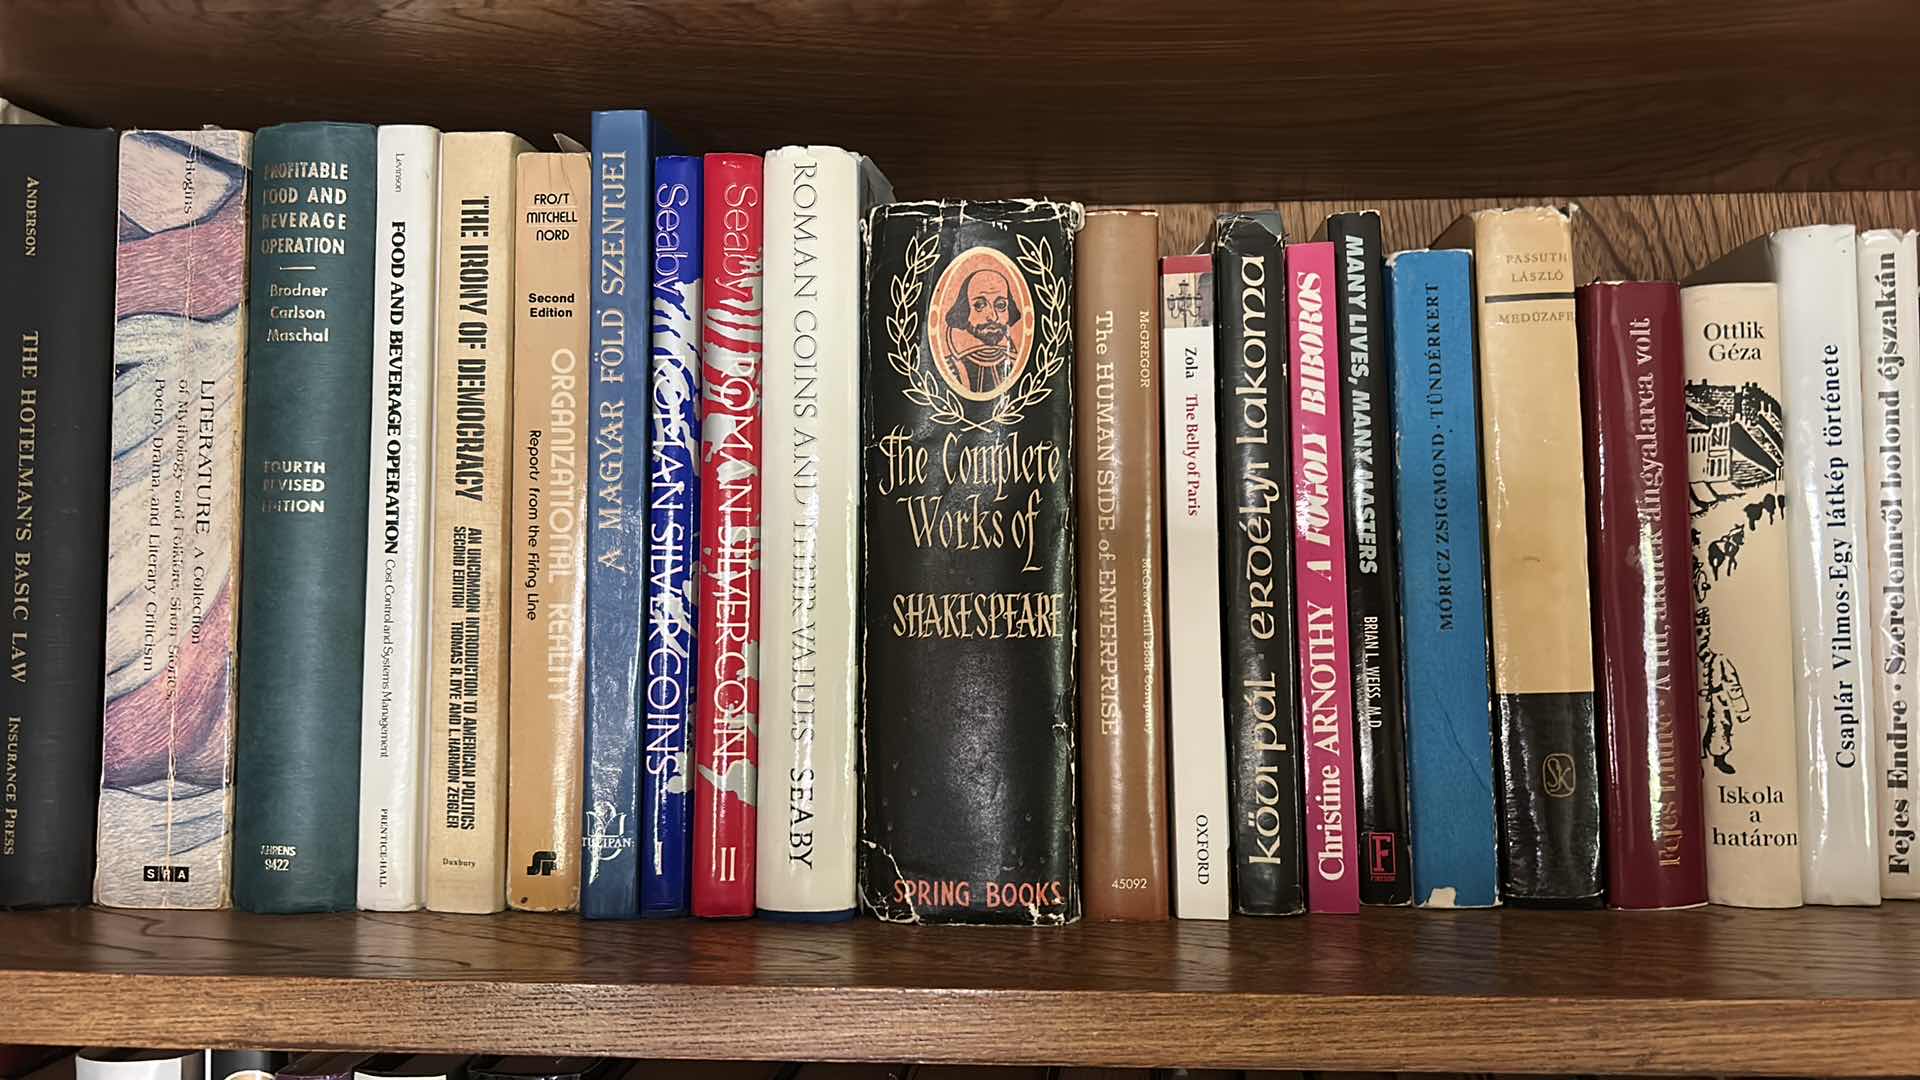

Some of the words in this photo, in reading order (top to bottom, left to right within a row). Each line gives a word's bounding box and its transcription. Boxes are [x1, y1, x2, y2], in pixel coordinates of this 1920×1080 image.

[183, 160, 196, 214] Hogins
[264, 162, 349, 180] PROFITABLE
[307, 187, 347, 205] AND
[24, 176, 40, 257] ANDERSON
[262, 212, 347, 230] BEVERAGE
[460, 196, 489, 237] THE
[527, 211, 577, 223] MITCHELL
[536, 229, 569, 241] NORD
[601, 151, 626, 296] SZENTJEI
[655, 183, 688, 296] Seaby
[715, 183, 758, 297] Seaby
[793, 162, 818, 298] ROMAN
[262, 237, 345, 255] OPERATION
[391, 221, 405, 278] FOOD
[1346, 235, 1368, 309] MANY
[1506, 252, 1568, 264] PASSUTH
[271, 283, 329, 297] Brodner
[459, 245, 489, 315] IRONY
[528, 293, 575, 303] Second
[1511, 269, 1564, 282] LÁSZLÓ
[271, 305, 326, 319] Carlson
[390, 282, 405, 325] AND
[529, 307, 573, 318] Edition
[1875, 252, 1905, 381] éjszakán
[21, 331, 39, 378] THE
[267, 327, 329, 342] Maschal
[458, 322, 488, 350] OF
[593, 308, 624, 383] FÖLD
[1096, 311, 1113, 354] The
[1139, 311, 1151, 388] McGREGOR
[1296, 271, 1327, 416] BIBOROS
[1348, 311, 1370, 385] LIVES,
[1424, 282, 1444, 419] TÜNDÉRKERT
[1630, 317, 1654, 366] volt
[1704, 321, 1765, 340] Ottlik
[1709, 344, 1762, 361] Géza
[178, 379, 189, 395] of
[387, 331, 404, 438] BEVERAGE
[793, 310, 818, 418] COINS
[1184, 347, 1197, 378] Zola
[1096, 362, 1115, 461] HUMAN
[1185, 394, 1198, 420] The
[1821, 344, 1842, 447] története
[454, 359, 487, 502] DEMOCRACY
[651, 354, 686, 510] ROMAN
[717, 357, 754, 512] ROMAN
[1183, 423, 1200, 458] Belly
[1351, 390, 1373, 464] MANY
[1878, 390, 1901, 489] bolond
[15, 389, 37, 542] HOTELMAN'S
[150, 437, 164, 492] Drama,
[193, 380, 215, 534] LITERATURE
[264, 460, 326, 474] FOURTH
[527, 430, 541, 481] Reports
[548, 349, 576, 584] ORGANIZATIONAL
[596, 400, 625, 530] MAGYAR
[793, 427, 817, 505] AND
[878, 425, 928, 496] The
[943, 431, 1060, 502] Complete
[1186, 460, 1200, 477] of
[149, 498, 161, 526] and
[384, 441, 401, 554] OPERATION
[527, 487, 540, 525] from
[1097, 470, 1116, 530] SIDE
[1187, 480, 1201, 516] Paris
[1302, 428, 1331, 547] FOGOLY
[1431, 434, 1449, 546] ZSIGMOND
[1825, 456, 1849, 527] látkép
[453, 526, 466, 564] SECOND
[468, 527, 482, 544] AN
[527, 527, 539, 547] the
[896, 494, 1004, 550] Works
[1011, 488, 1043, 573] of
[1354, 465, 1378, 574] MASTERS
[145, 535, 160, 595] Literary
[194, 547, 204, 559] A
[384, 559, 397, 584] Cost
[524, 552, 539, 589] Firing
[598, 547, 625, 573] A
[1098, 540, 1116, 560] of
[1307, 559, 1332, 582] A
[12, 551, 32, 620] BASIC
[191, 565, 204, 645] Collection
[382, 585, 396, 624] Control
[451, 566, 465, 609] EDITION
[466, 550, 482, 613] UNCOMMON
[527, 593, 539, 621] Line
[649, 522, 683, 640] SILVER
[714, 526, 752, 645] SILVER
[1436, 549, 1454, 632] MÓRICZ
[1881, 498, 1907, 674] Szerelemről
[143, 602, 157, 672] Criticism
[382, 625, 394, 645] and
[893, 592, 1064, 639] SHAKESPEARE
[1364, 616, 1378, 649] BRIAN
[10, 632, 27, 684] LAW
[380, 646, 394, 689] Systems
[450, 621, 463, 664] THOMAS
[464, 616, 481, 697] INTRODUCTION
[547, 603, 574, 703] REALITY
[1099, 569, 1119, 735] ENTERPRISE
[1365, 652, 1379, 662] L.
[449, 683, 462, 700] DYE
[791, 623, 816, 742] VALUES
[1307, 600, 1340, 757] ARNOTHY
[378, 691, 393, 758] Management
[448, 702, 461, 727] AND
[463, 701, 477, 714] TO
[646, 649, 681, 775] COINS
[1834, 680, 1859, 768] Csaplár
[461, 717, 477, 777] AMERICAN
[1886, 700, 1909, 790] Endre
[446, 786, 459, 829] ZEIGLER
[460, 780, 476, 831] POLITICS
[789, 768, 814, 869] SEABY
[1719, 785, 1784, 804] Iskola
[1750, 811, 1760, 824] a
[1316, 764, 1345, 881] Christine
[1713, 828, 1798, 847] határon
[1888, 799, 1915, 875] Fejes
[264, 858, 290, 871] 9422
[443, 857, 476, 868] Duxbury
[1196, 814, 1209, 885] OXFORD
[894, 880, 970, 906] SPRING
[986, 881, 1063, 908] BOOKS
[1112, 878, 1147, 890] 45092
